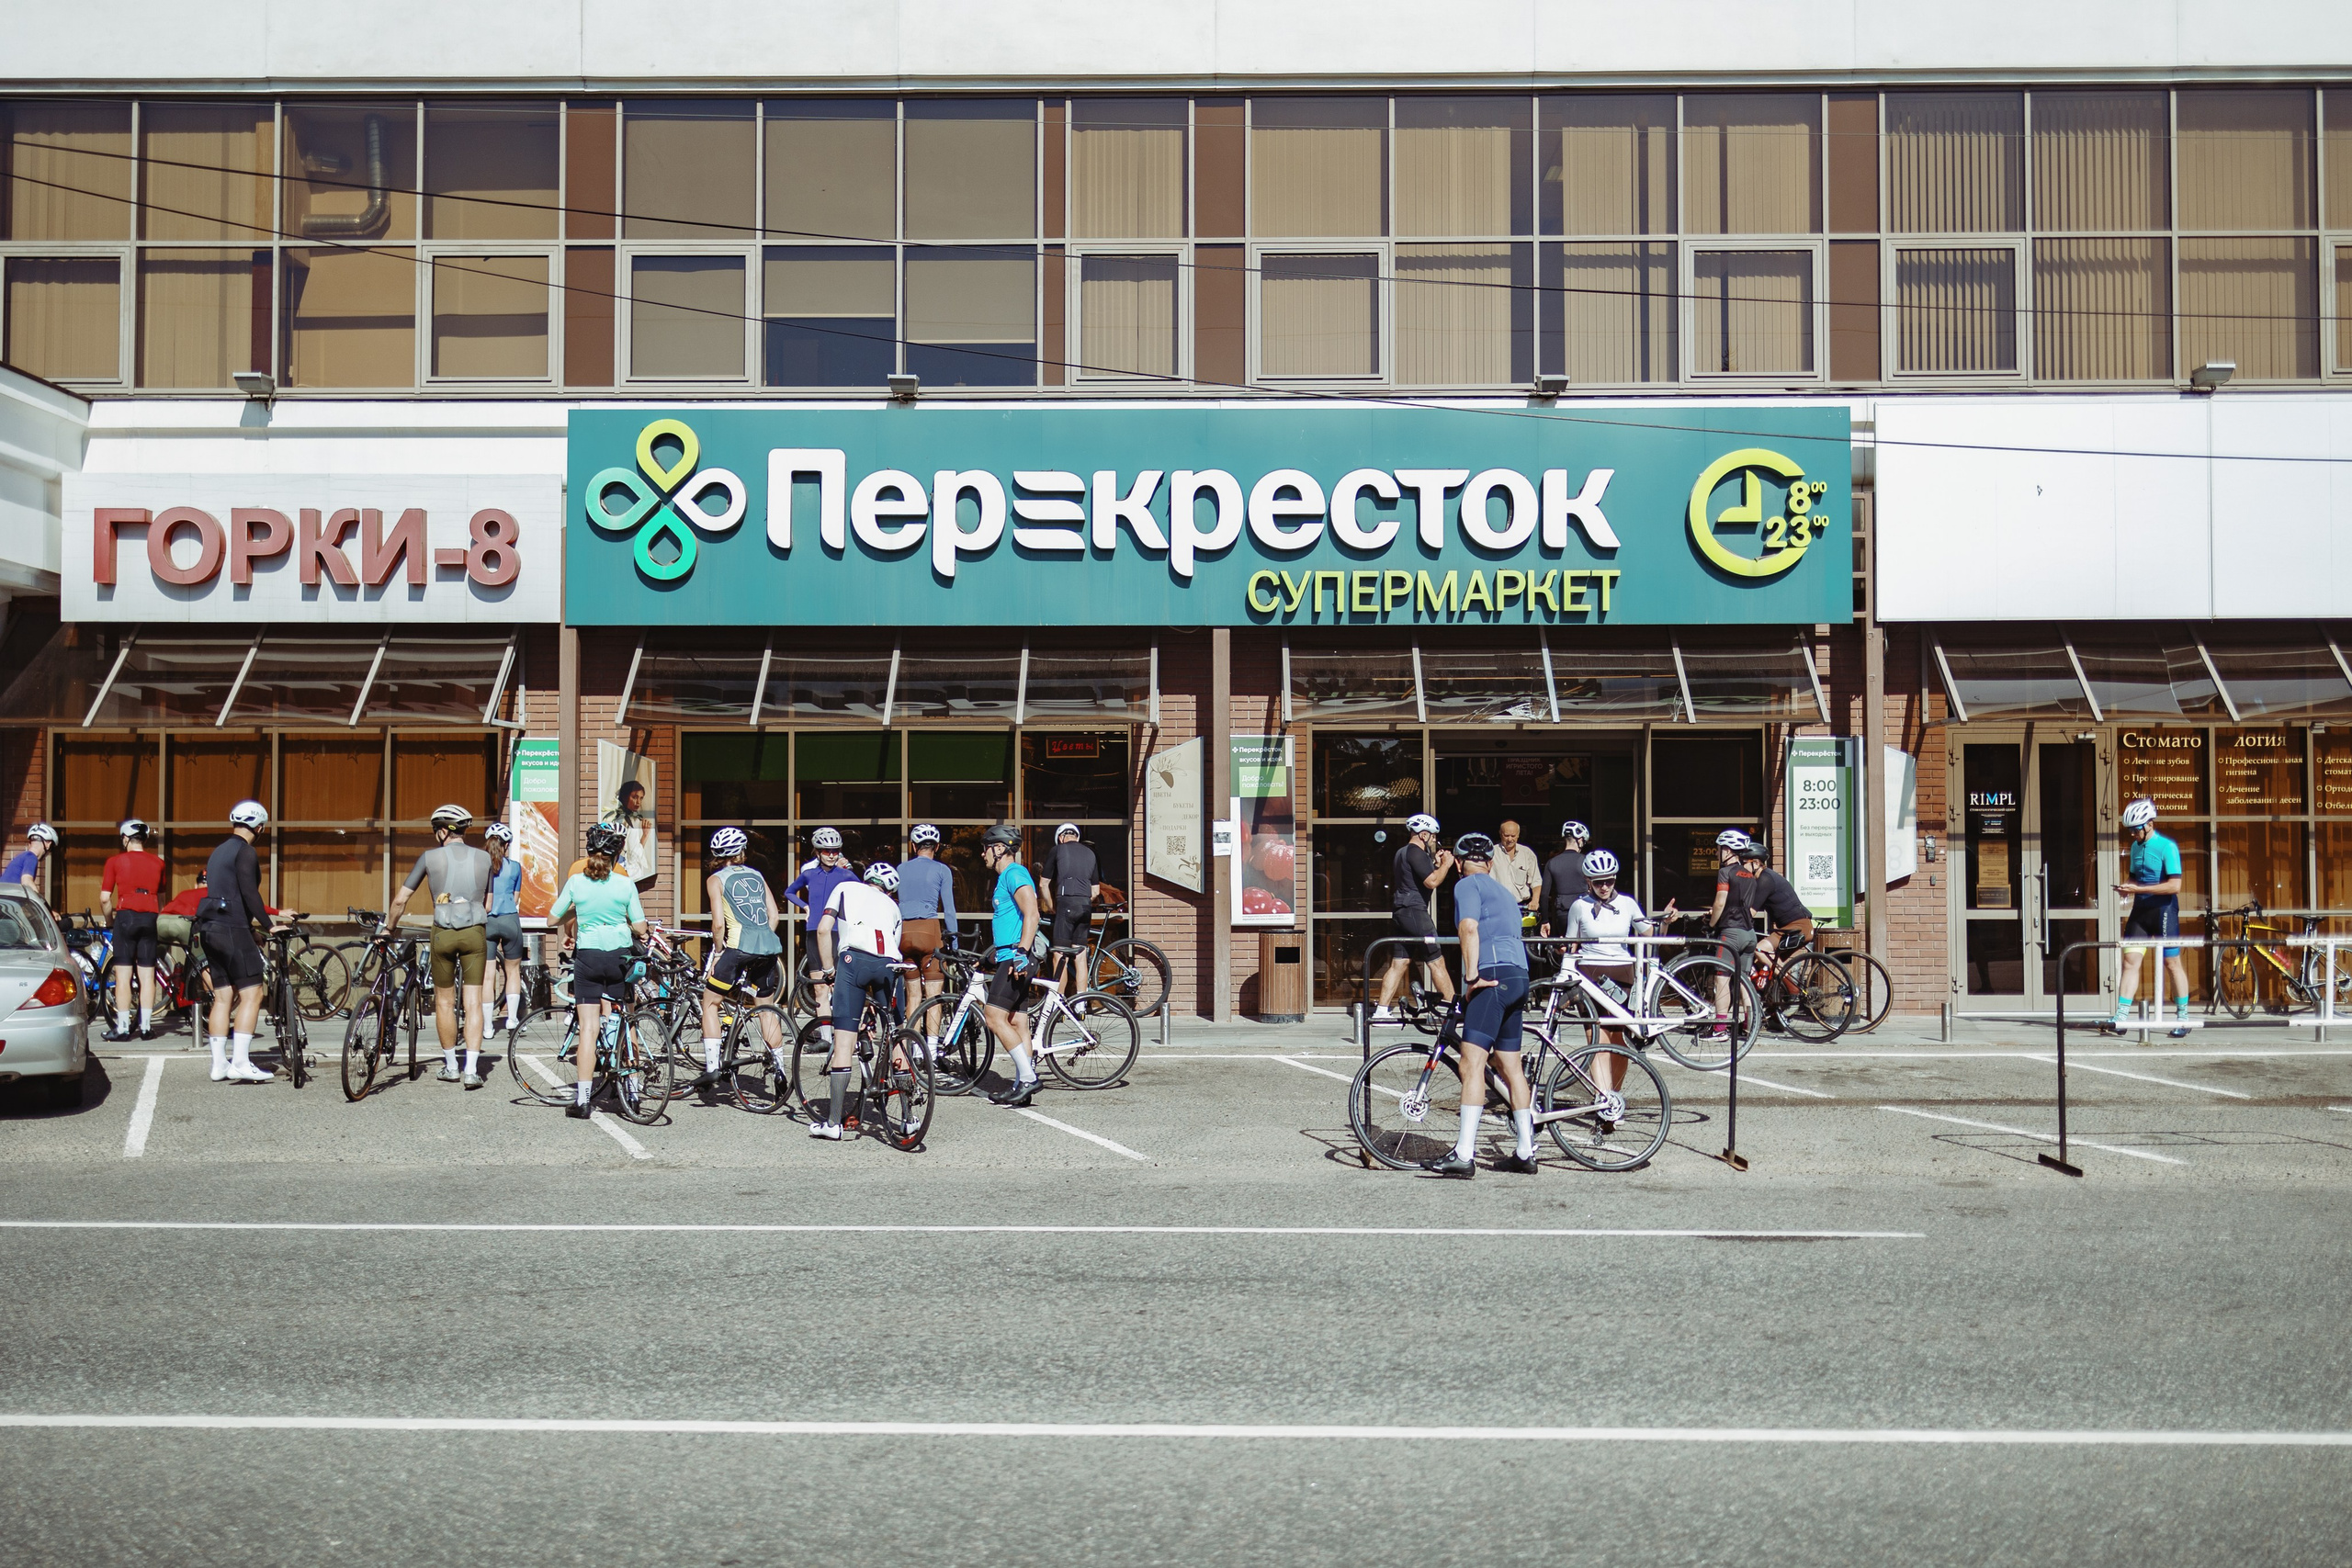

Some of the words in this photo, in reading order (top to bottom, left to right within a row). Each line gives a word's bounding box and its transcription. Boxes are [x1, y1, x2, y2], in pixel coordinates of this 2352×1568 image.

[766, 446, 1621, 580] Перекресток
[94, 506, 521, 586] ГОРКИ-8
[1248, 570, 1622, 614] СУПЕРМАРКЕТ
[1052, 739, 1094, 753] Цветы
[2122, 732, 2201, 748] Стомато
[2234, 736, 2287, 748] логия
[1798, 750, 1842, 758] Перекрёсток
[2167, 758, 2190, 767] зубов
[2132, 774, 2199, 784] Протезирование
[1803, 780, 1837, 792] 8:00
[1799, 797, 1840, 810] 23:00
[1970, 793, 2016, 806] RIMPL
